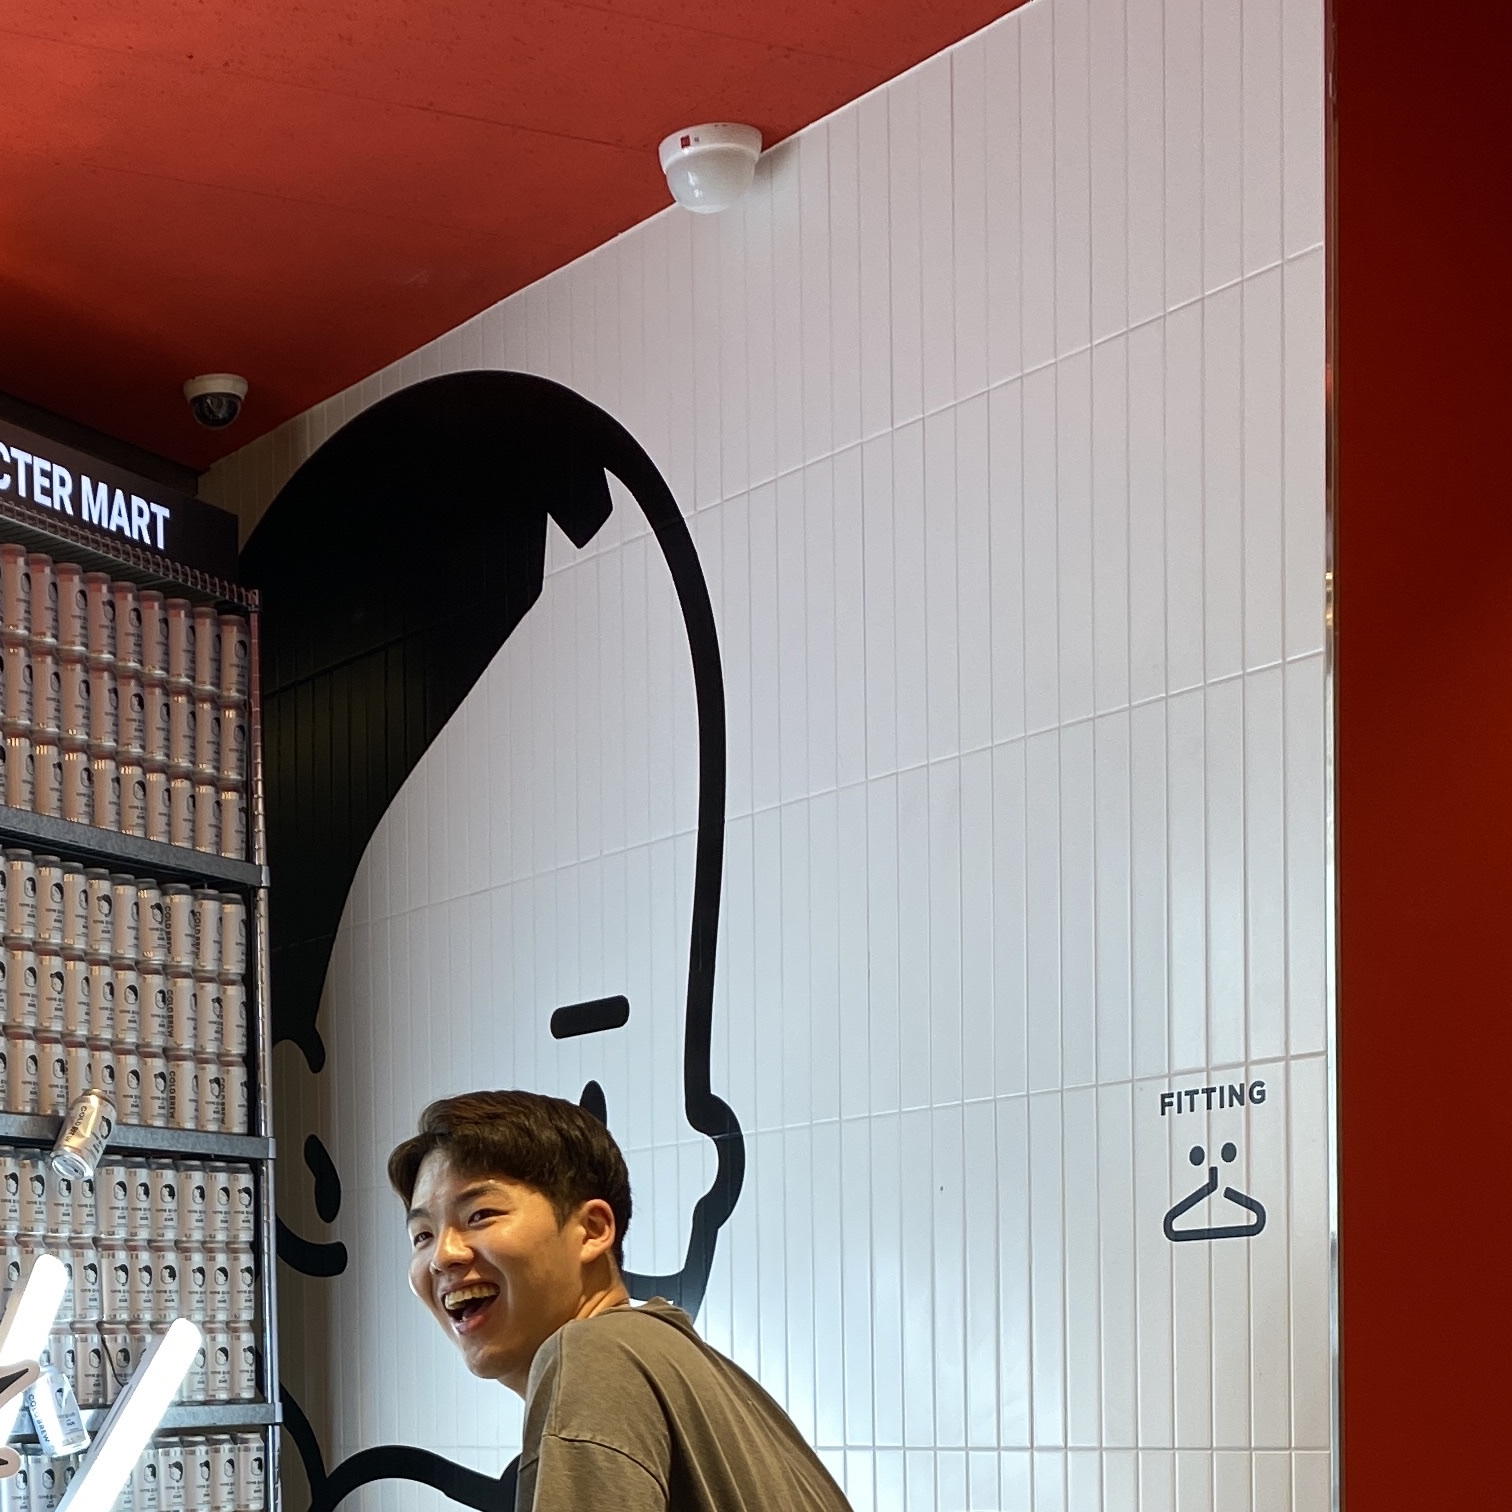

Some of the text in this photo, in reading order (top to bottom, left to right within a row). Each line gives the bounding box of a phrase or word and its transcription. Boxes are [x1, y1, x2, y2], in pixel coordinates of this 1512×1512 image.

[81, 477, 171, 550] MART
[1160, 1080, 1266, 1116] FITTING
[65, 1106, 87, 1142] COLD BREW
[28, 1394, 50, 1443] COLD BREW
